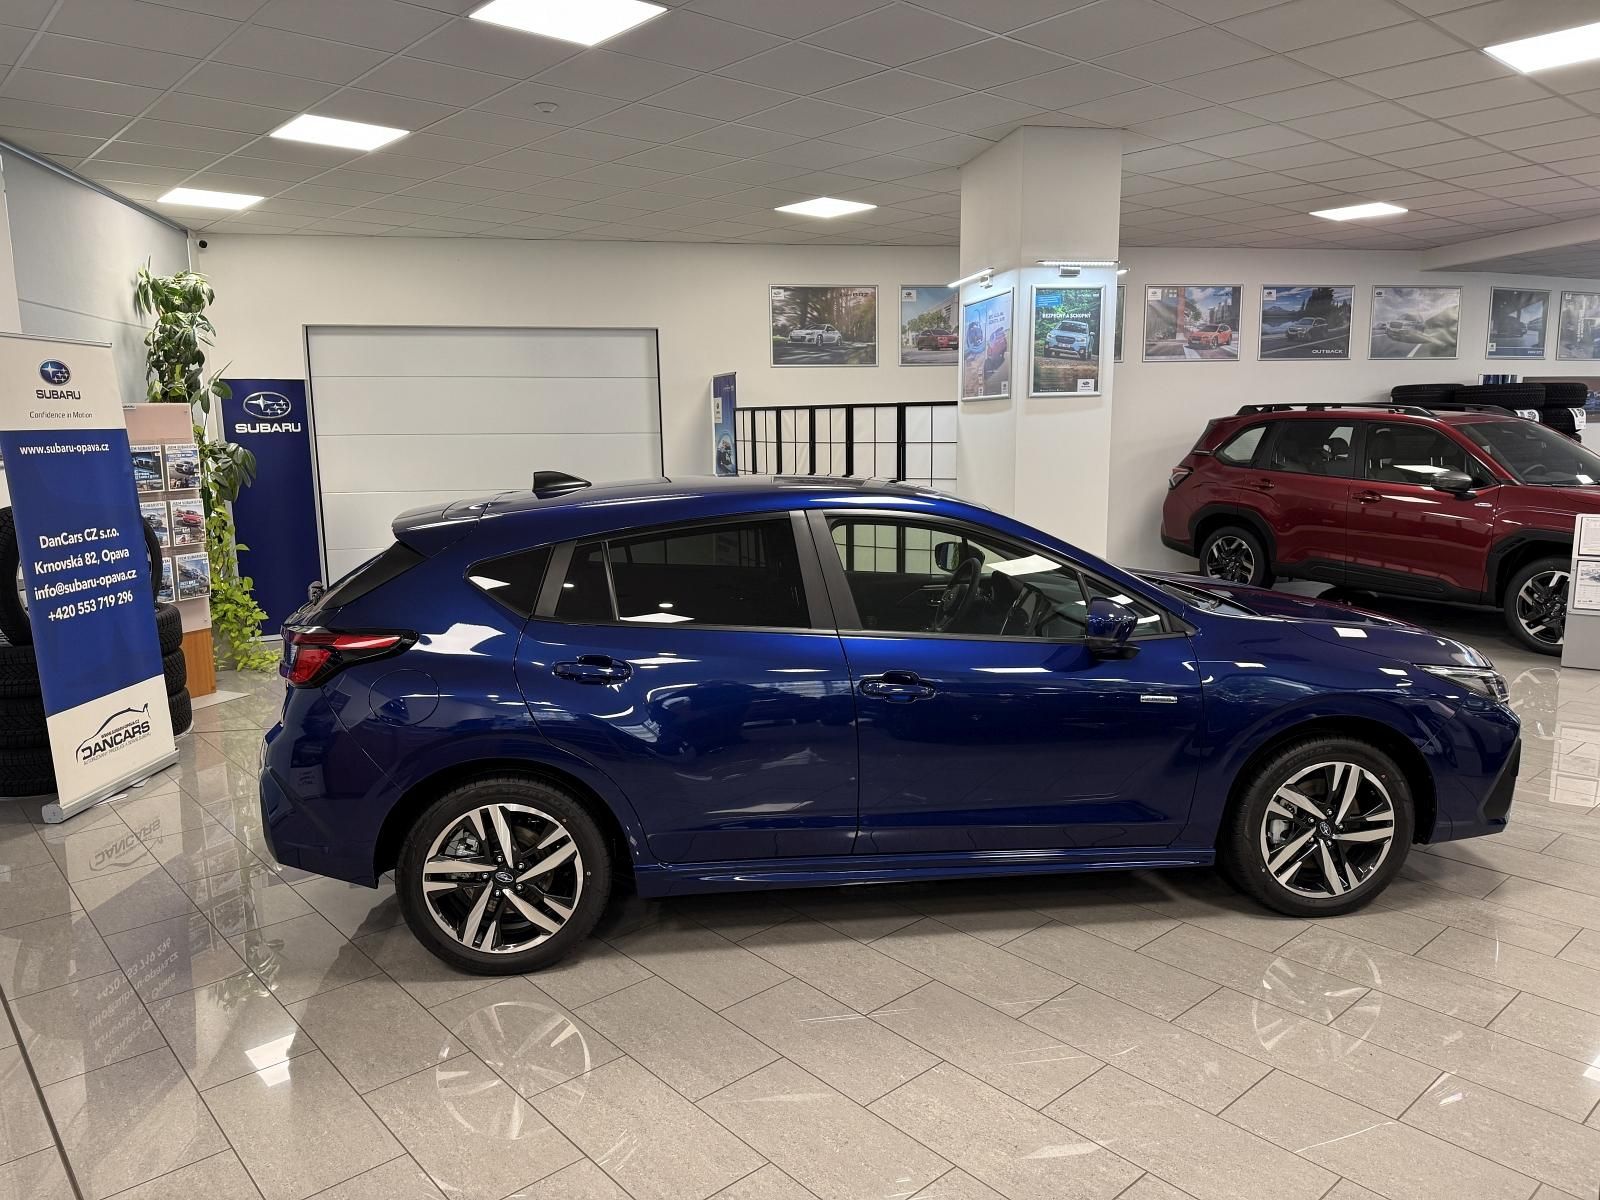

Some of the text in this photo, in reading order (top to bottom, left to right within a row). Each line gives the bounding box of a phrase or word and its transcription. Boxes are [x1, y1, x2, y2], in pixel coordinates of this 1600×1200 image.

[36, 389, 81, 400] SUBARU
[30, 411, 65, 419] Confidence
[72, 411, 93, 419] Motion
[235, 422, 302, 433] SUBARU
[19, 443, 109, 455] www.subaru-opava.cz
[39, 528, 119, 549] DanCars CZ s.r.o.
[34, 548, 130, 575] Krnovská 82, Opava
[34, 569, 138, 601] info@subaru-opava.cz
[48, 590, 134, 621] +420 553 719 296
[81, 720, 150, 760] DANCARS
